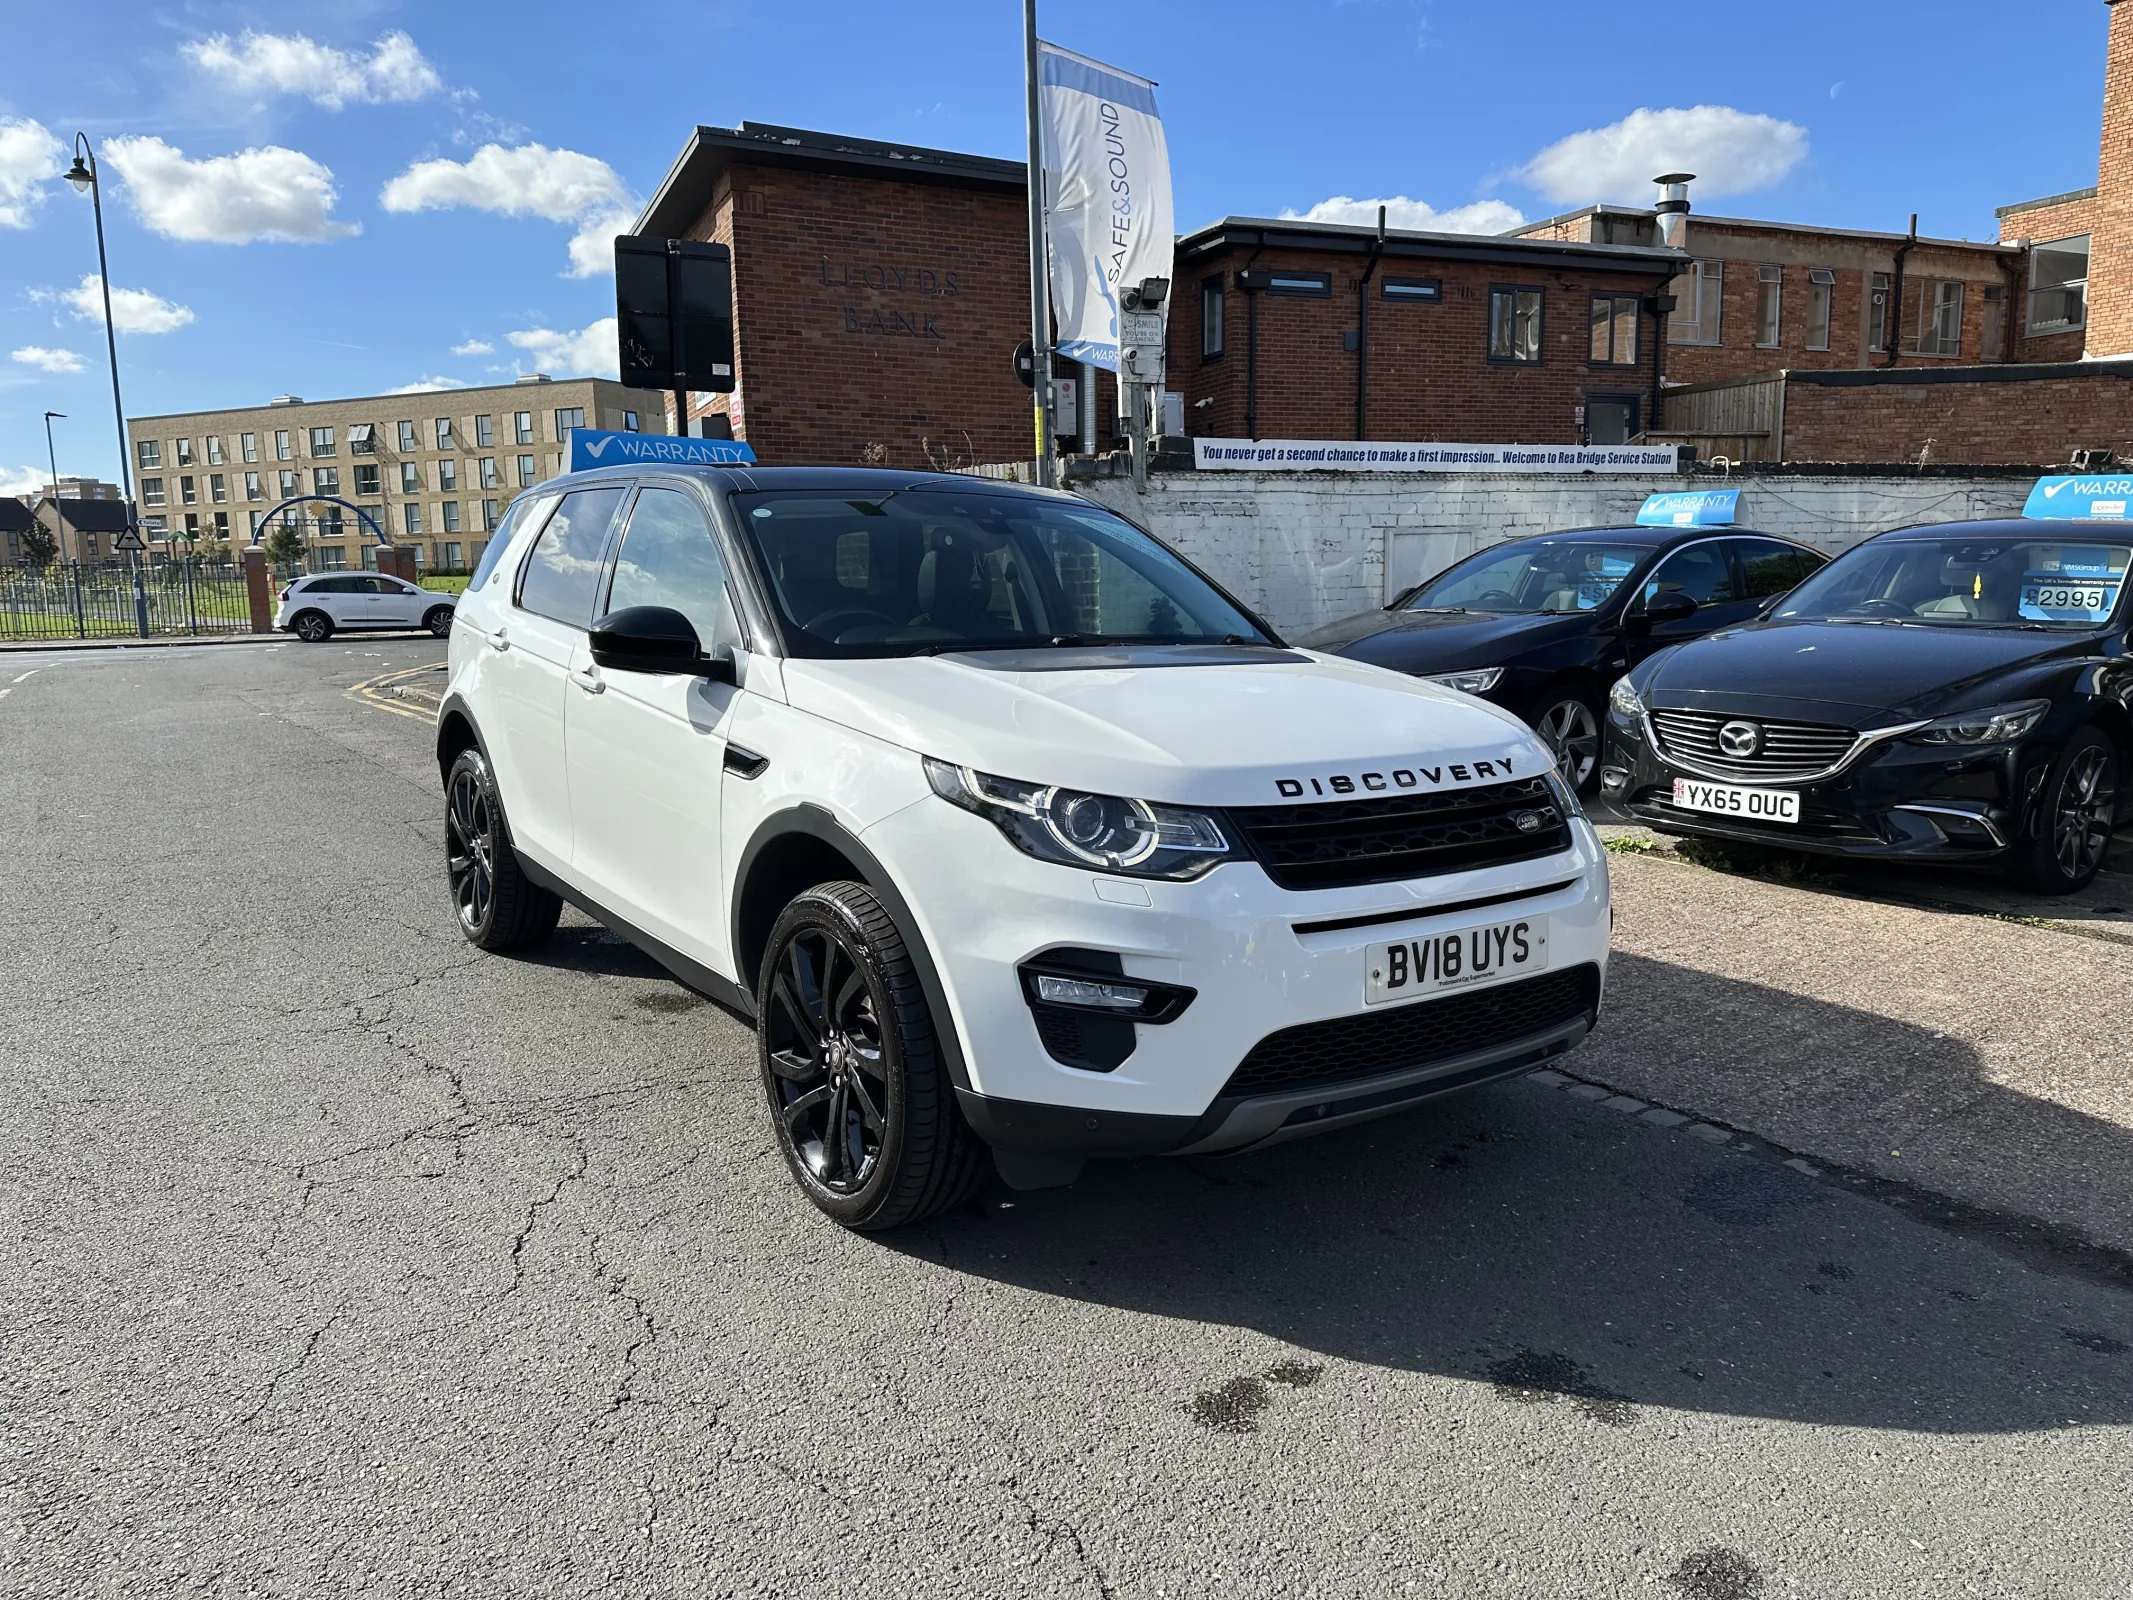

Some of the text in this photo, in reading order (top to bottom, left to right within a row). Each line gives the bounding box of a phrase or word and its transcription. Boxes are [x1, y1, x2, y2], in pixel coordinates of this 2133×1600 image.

[1100, 102, 1131, 284] SAFE&SOUND
[822, 258, 960, 297] LLOYDS
[844, 305, 947, 340] BANK
[1136, 320, 1159, 329] SMILE
[617, 439, 743, 463] WARRANTY
[1203, 445, 1223, 460] You
[1225, 448, 1256, 460] never
[1257, 448, 1276, 462] get
[1278, 450, 1285, 461] a
[1286, 448, 1326, 461] second
[1327, 448, 1366, 461] chance
[1367, 450, 1378, 461] to
[1380, 449, 1408, 462] make
[1409, 452, 1416, 462] a
[1417, 450, 1439, 463] first
[1502, 451, 1546, 464] Welcome
[1547, 452, 1557, 464] to
[1558, 452, 1575, 464] Rea
[1576, 452, 1606, 466] Bridge
[1607, 452, 1640, 465] Service
[1641, 452, 1672, 465] Station
[1664, 494, 1732, 509] WARRANTY
[2061, 563, 2100, 572] WMSGroup
[1275, 757, 1513, 798] DISCOVERY
[1688, 784, 1794, 818] YX65 OUC
[1387, 922, 1530, 989] BV18 UYS
